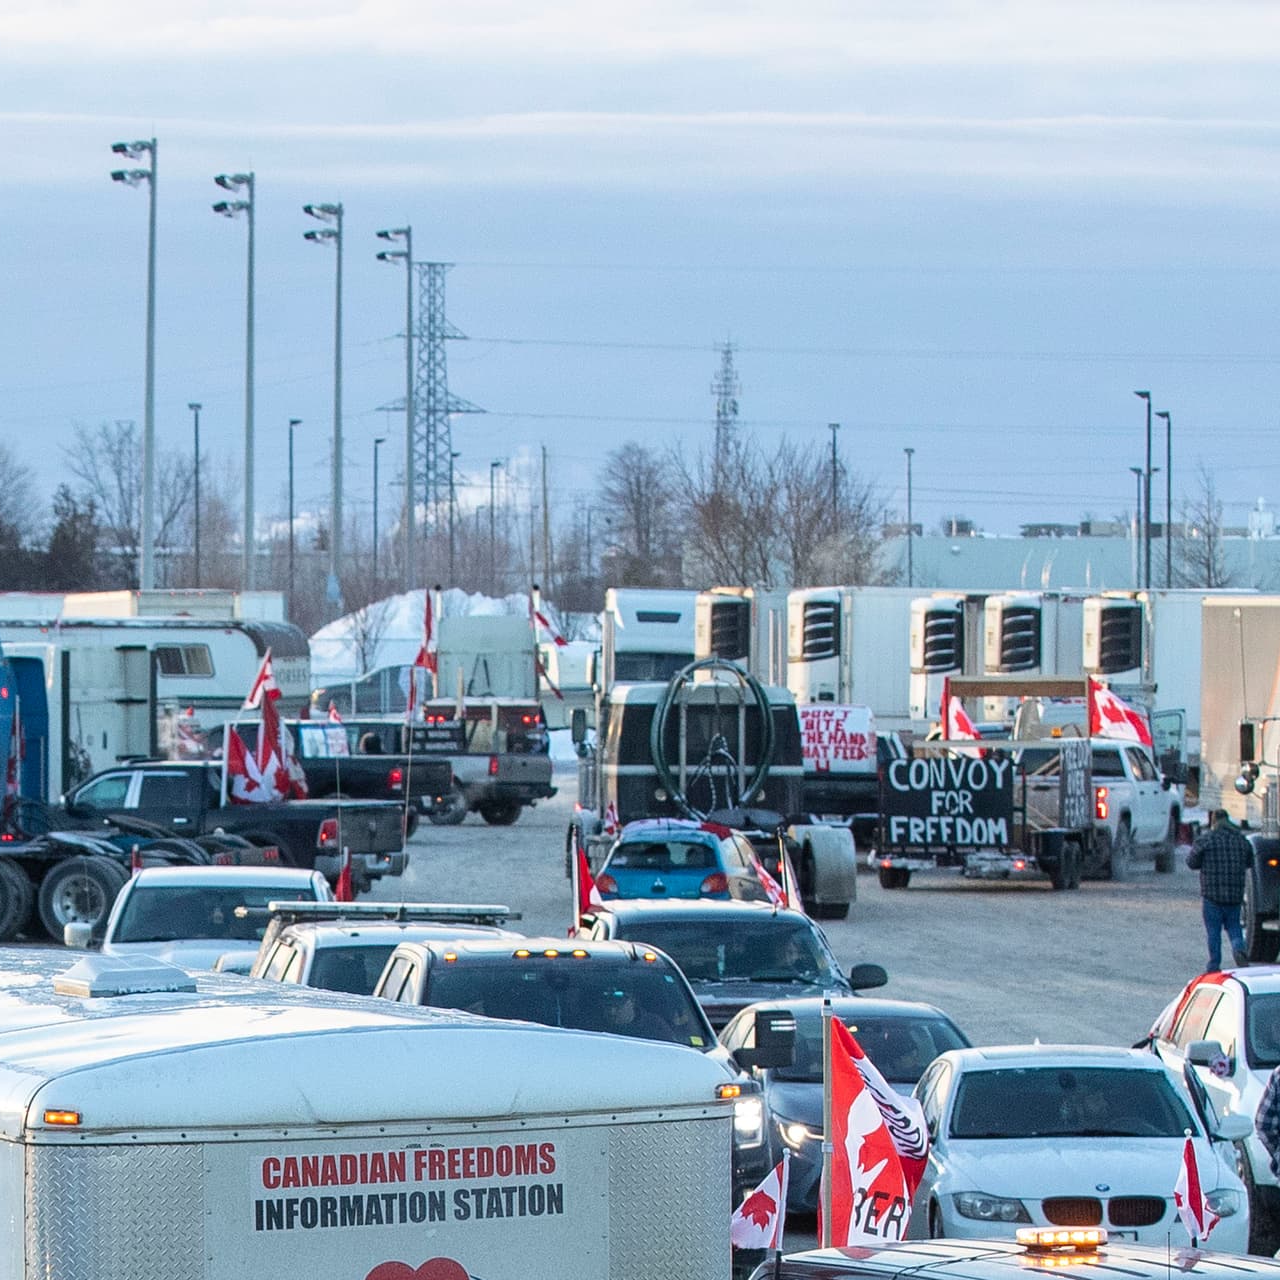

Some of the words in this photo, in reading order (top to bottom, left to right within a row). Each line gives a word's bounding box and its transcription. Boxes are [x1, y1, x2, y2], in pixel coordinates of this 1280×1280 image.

[888, 758, 1010, 792] CONVOY
[931, 790, 974, 815] FOR
[262, 1151, 406, 1189] CANADIAN
[414, 1142, 557, 1181] FREEDOMS
[255, 1190, 447, 1231] INFORMATION
[454, 1183, 564, 1221] STATION
